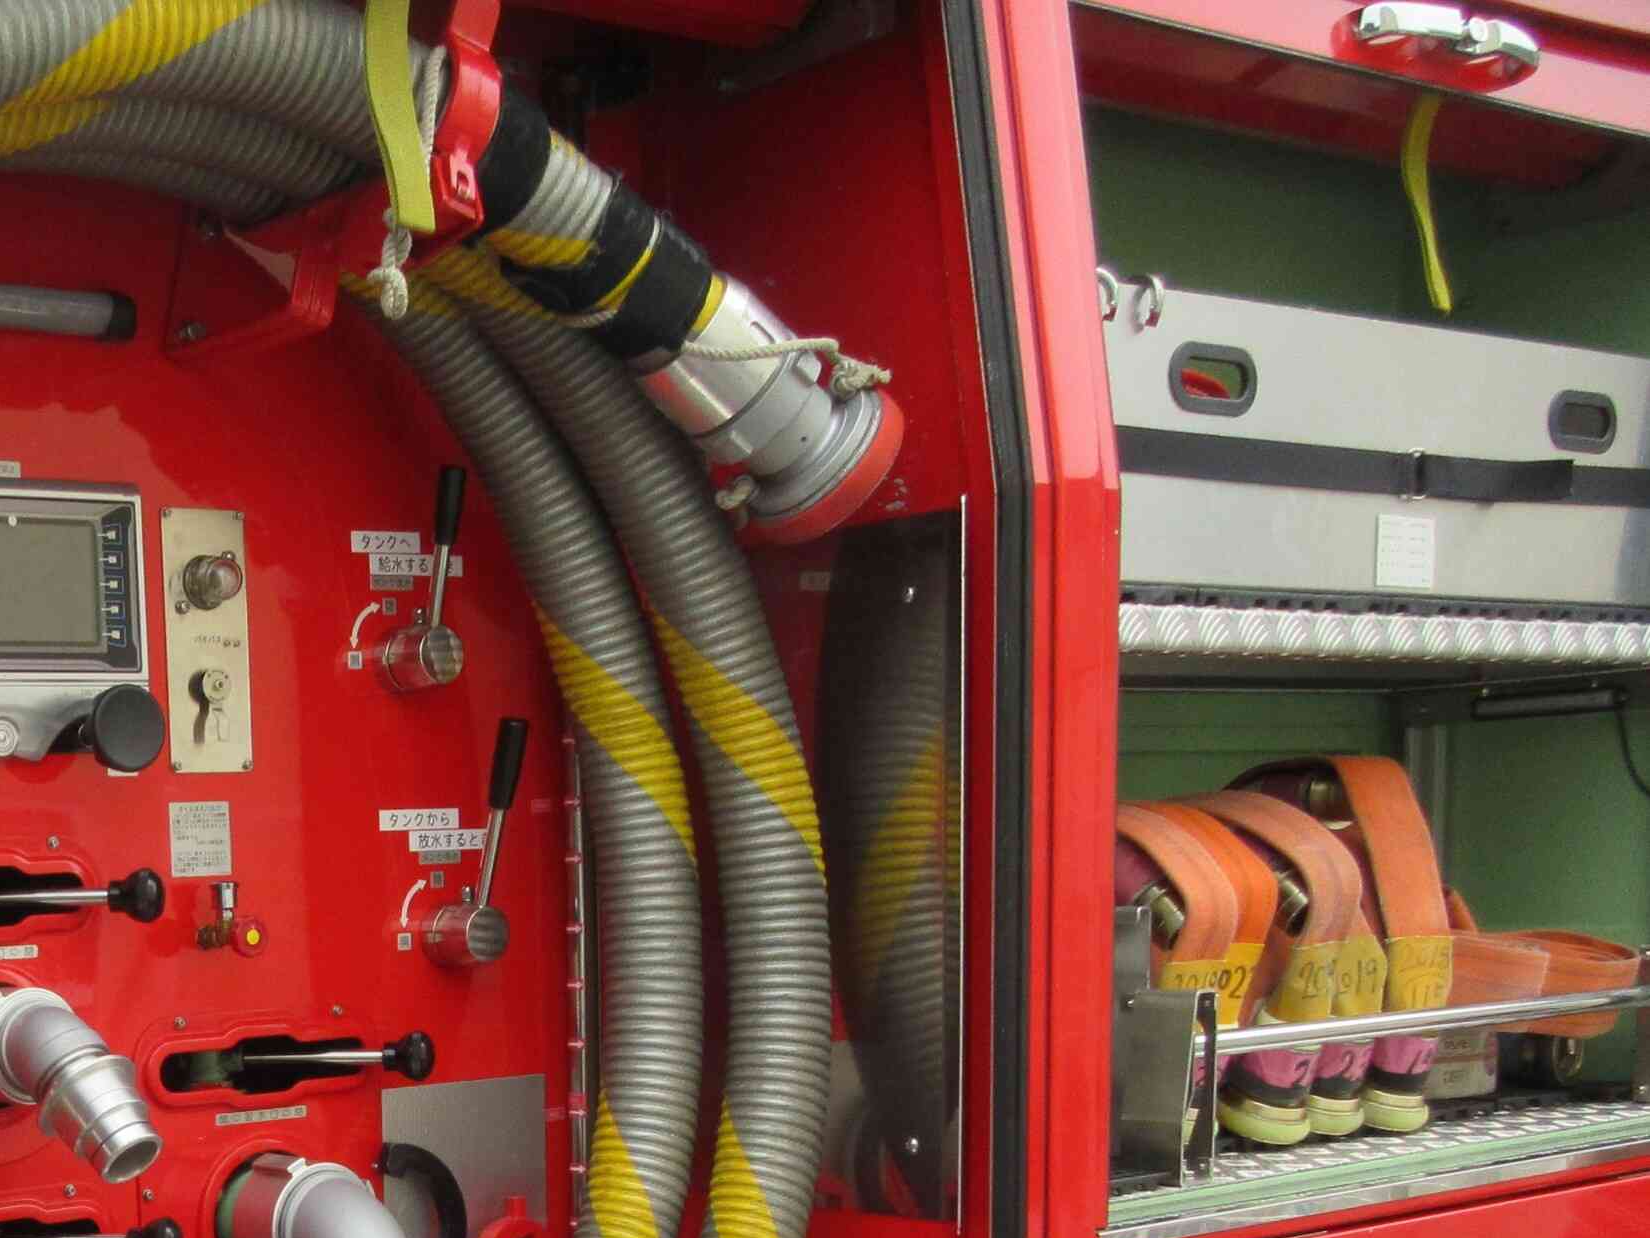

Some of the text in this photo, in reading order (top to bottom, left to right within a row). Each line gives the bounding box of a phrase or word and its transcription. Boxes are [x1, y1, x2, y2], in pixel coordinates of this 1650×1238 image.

[360, 534, 411, 550] タンクへ
[389, 811, 450, 828] タンクから
